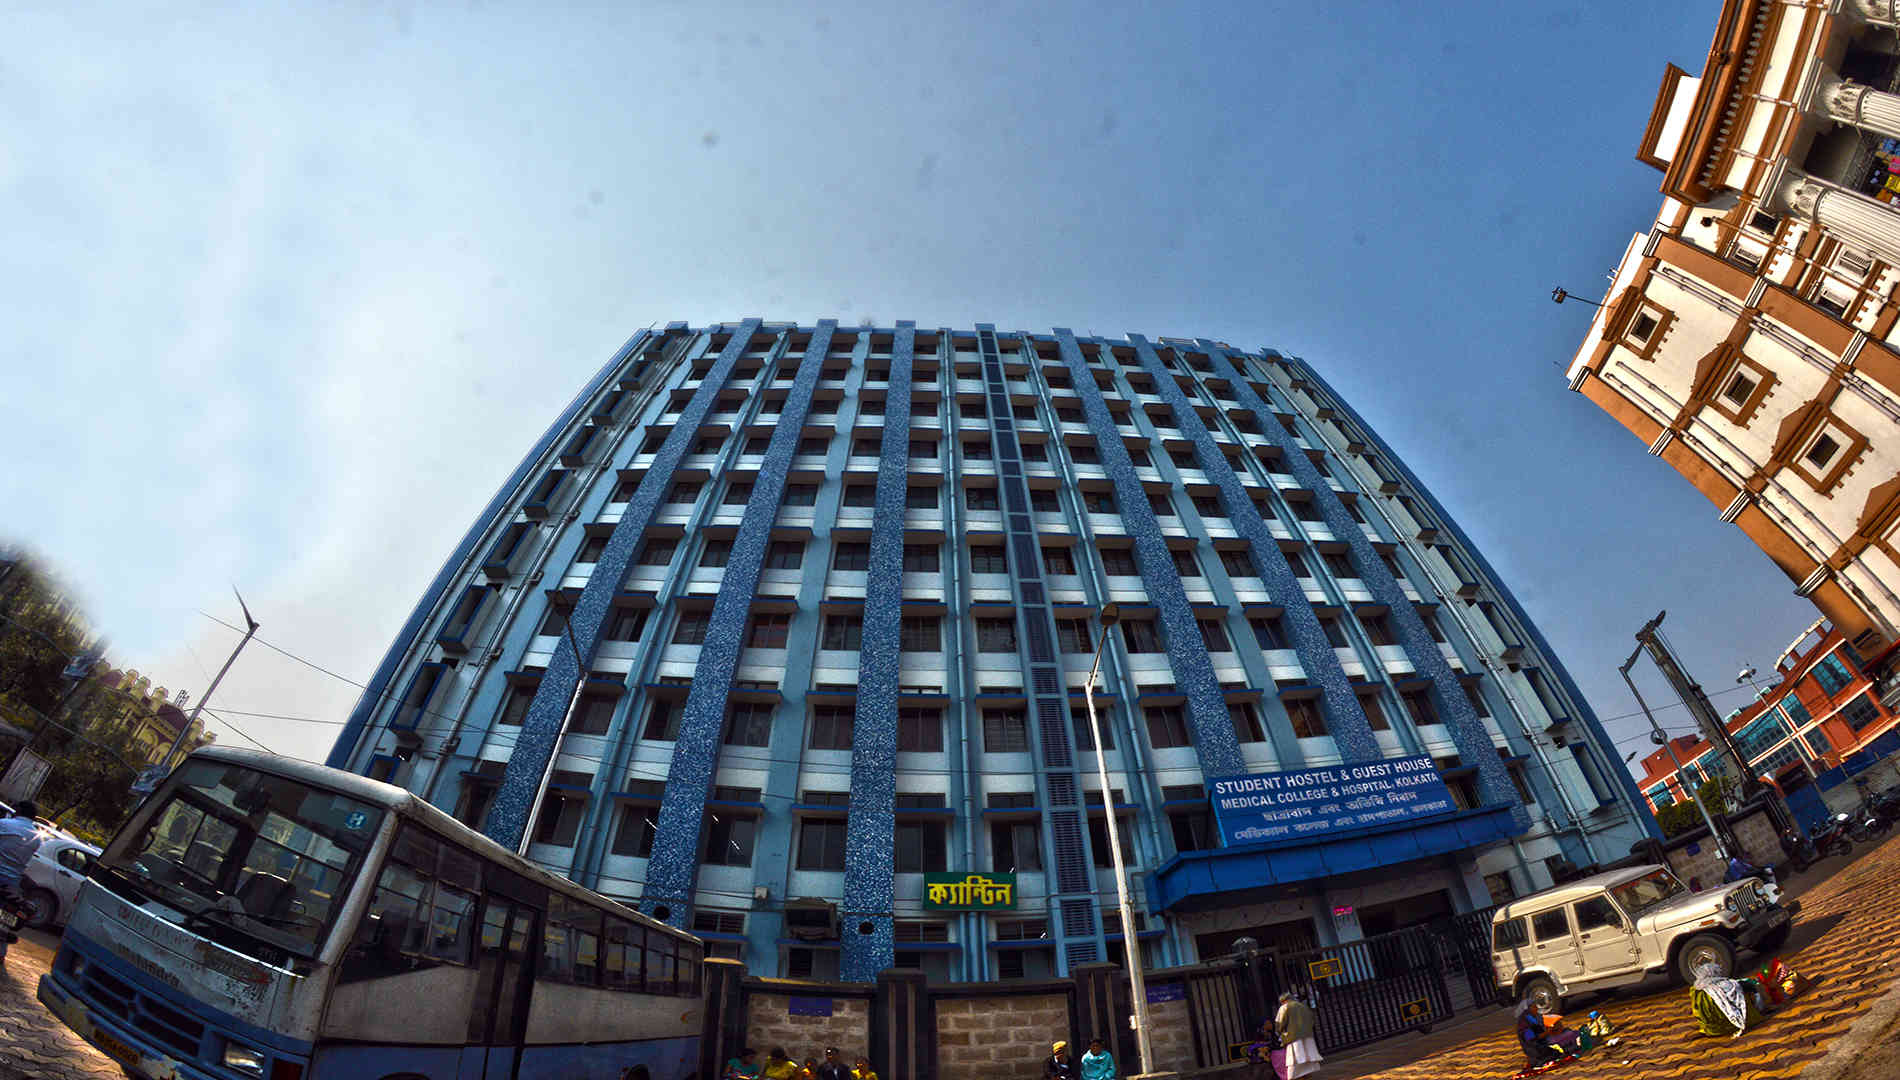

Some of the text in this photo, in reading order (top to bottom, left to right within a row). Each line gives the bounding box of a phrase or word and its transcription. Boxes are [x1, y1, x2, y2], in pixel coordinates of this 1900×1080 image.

[1216, 758, 1433, 794] STUDENT HOSTEL & GUEST HOUSE
[1221, 795, 1275, 809] MEDICAL
[1277, 788, 1329, 803] COLLEGE
[1331, 787, 1340, 797] &
[1395, 772, 1439, 788] KOLKATA
[928, 875, 1012, 905] ক্যান্টিন
